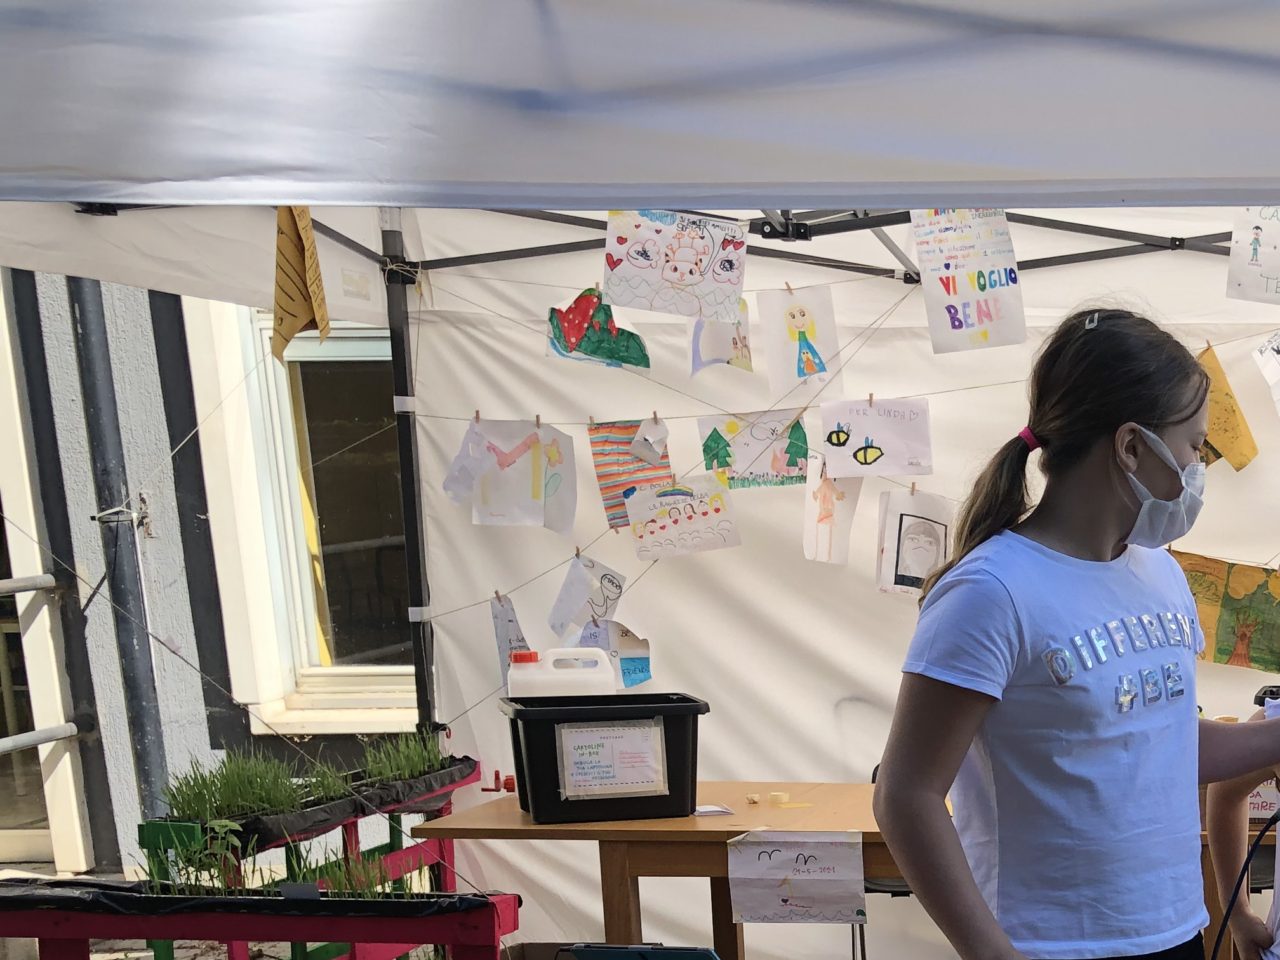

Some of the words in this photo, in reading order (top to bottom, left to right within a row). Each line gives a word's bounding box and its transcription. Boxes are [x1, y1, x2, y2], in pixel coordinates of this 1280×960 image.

[939, 275, 958, 296] VI
[966, 267, 1018, 292] VOGLIO
[1040, 612, 1196, 687] DIFFEREN
